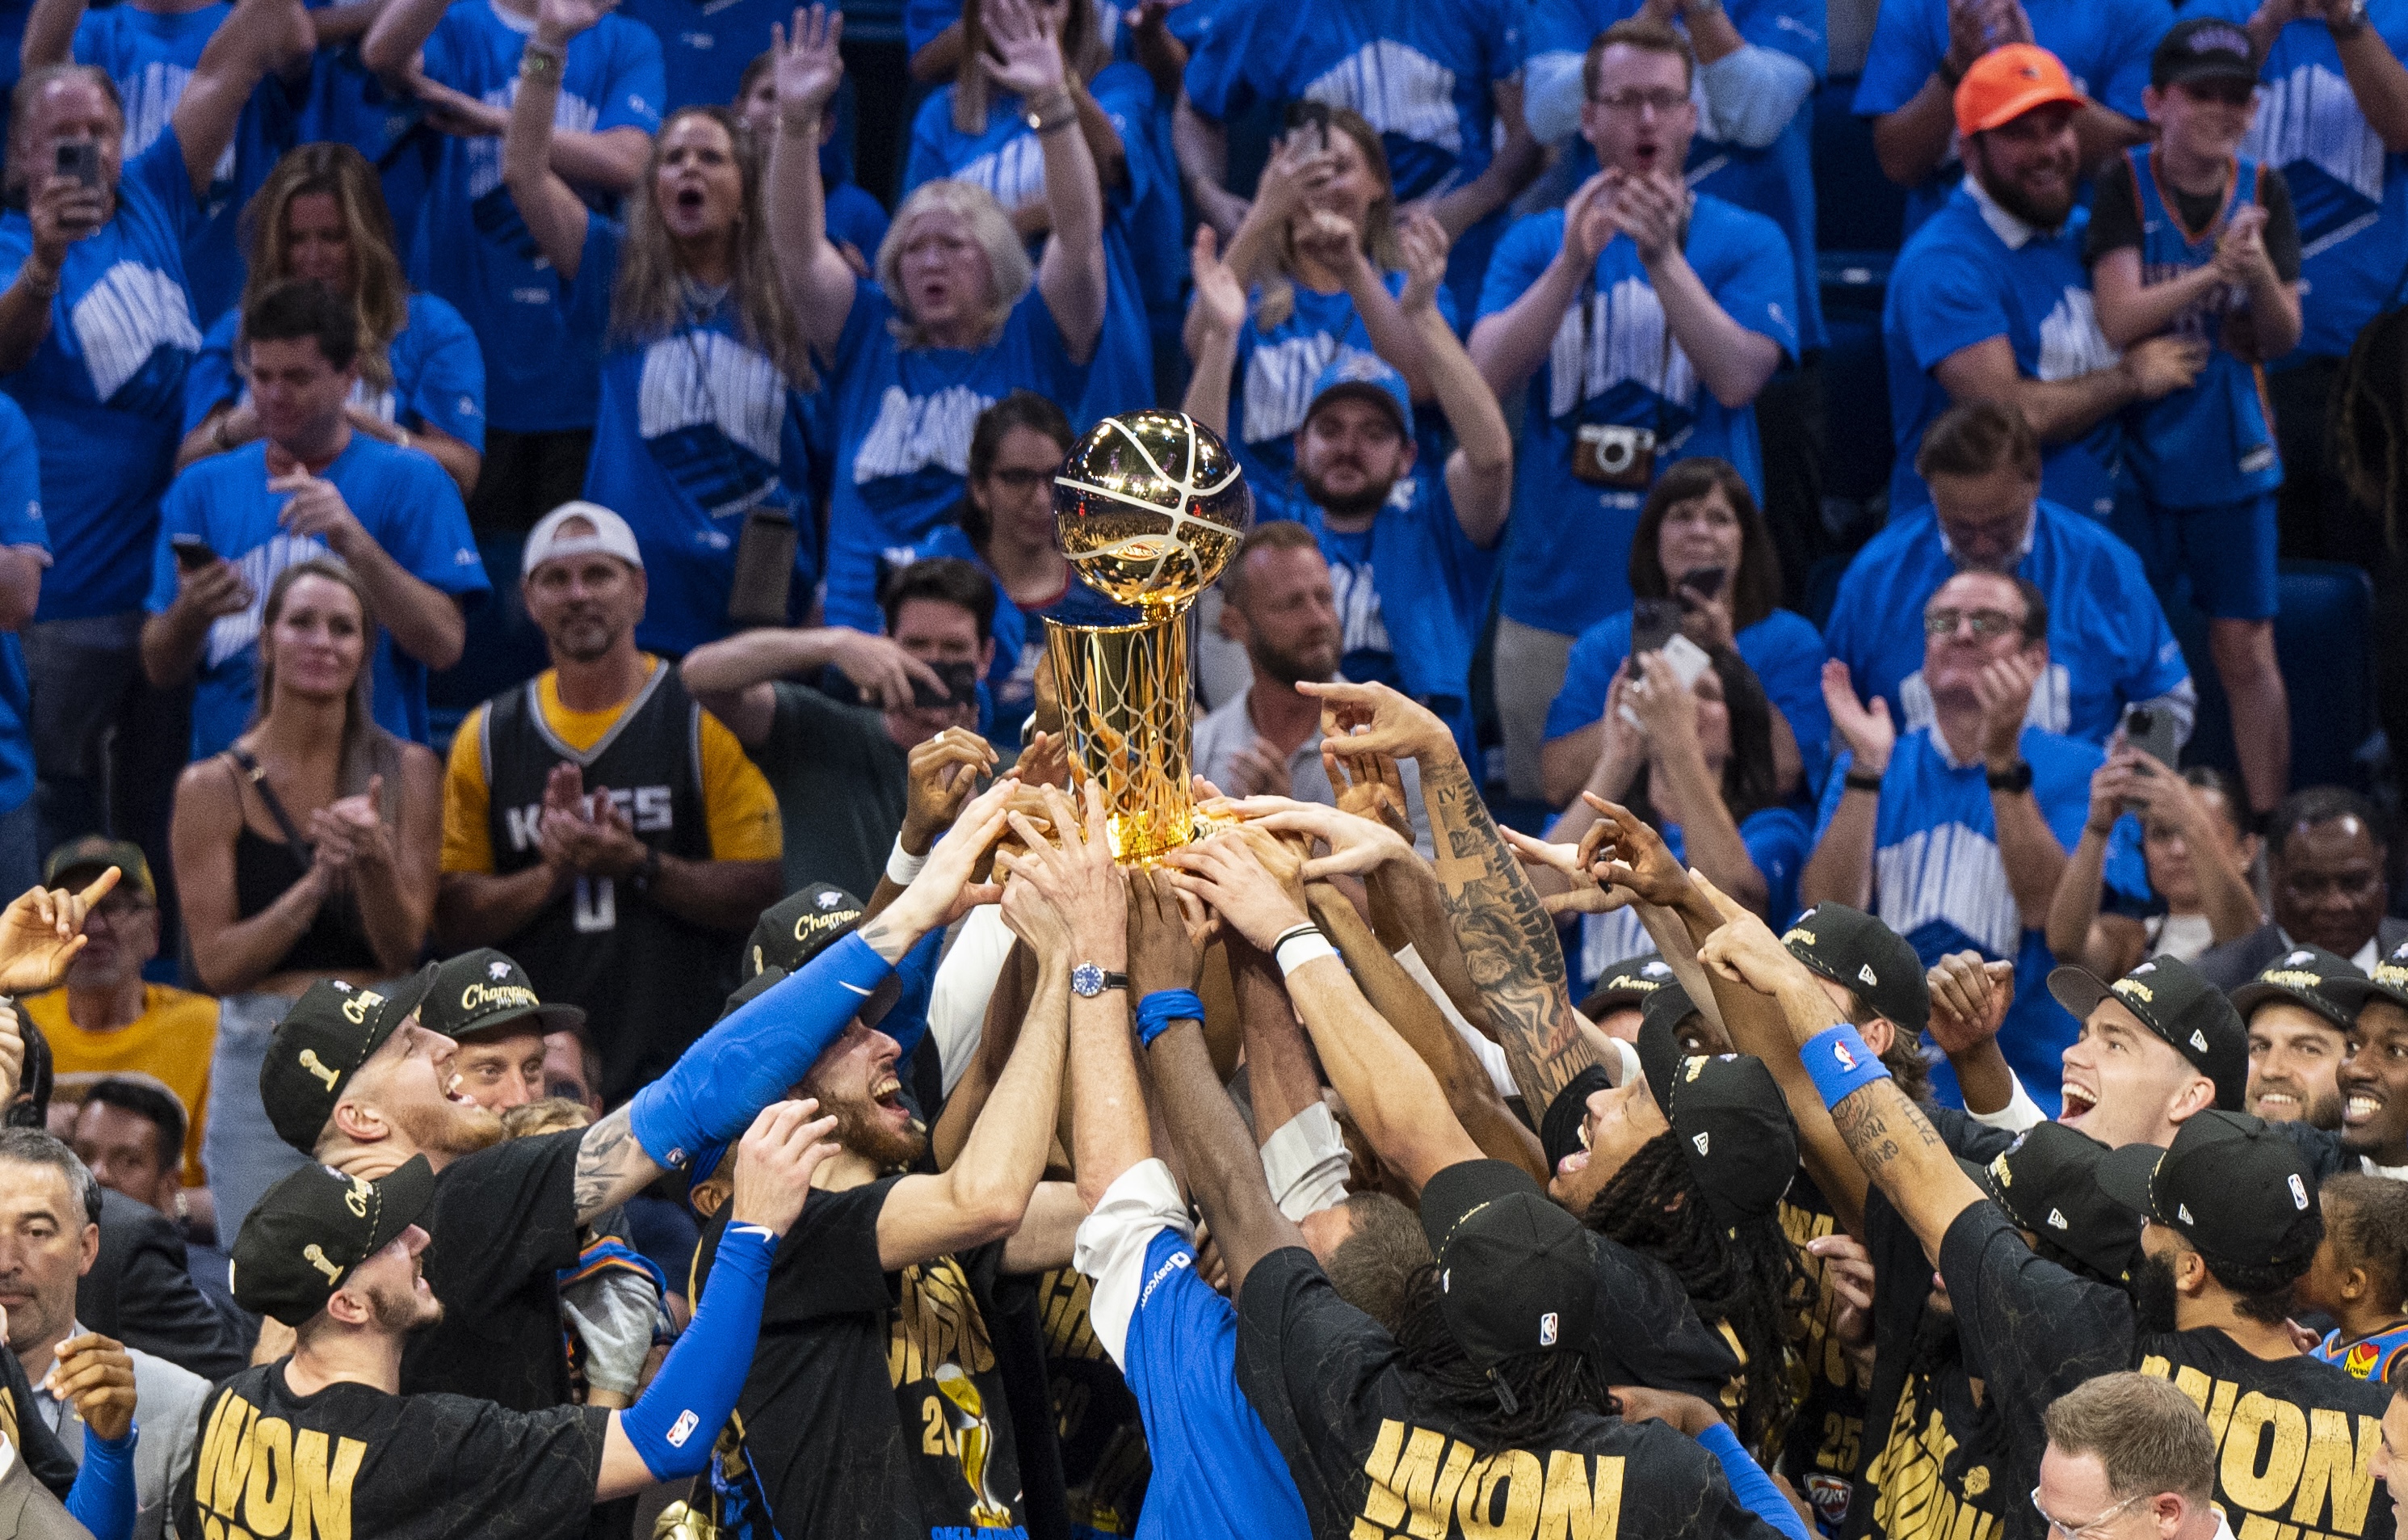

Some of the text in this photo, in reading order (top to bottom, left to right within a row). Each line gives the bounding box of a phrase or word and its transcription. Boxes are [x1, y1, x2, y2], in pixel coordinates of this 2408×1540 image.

[1141, 1260, 1175, 1312] paycom
[195, 1386, 368, 1540] WON
[1364, 1417, 1626, 1540] WON
